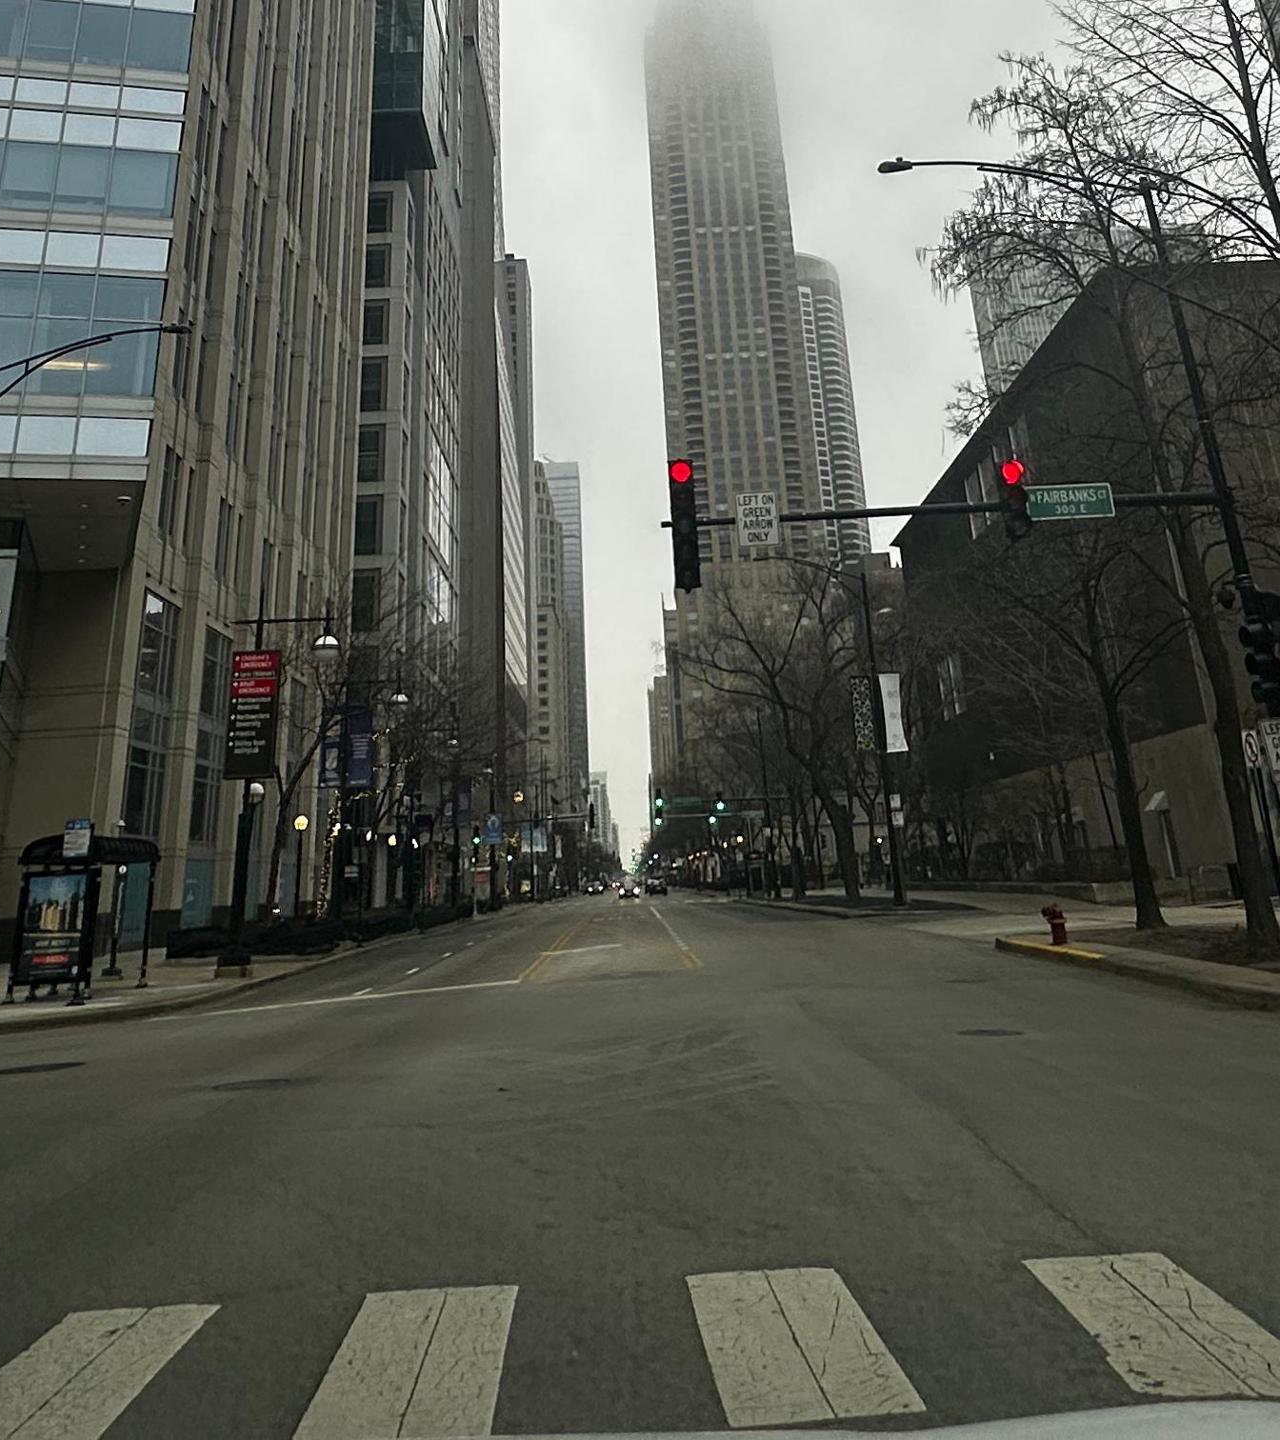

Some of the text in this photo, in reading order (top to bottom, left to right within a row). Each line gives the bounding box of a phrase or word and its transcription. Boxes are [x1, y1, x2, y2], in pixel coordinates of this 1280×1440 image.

[737, 494, 774, 507] LEFT ON
[1036, 488, 1097, 504] FAIRBANKS
[742, 506, 772, 519] GREEN
[1055, 503, 1088, 514] 300 E
[742, 518, 773, 530] ARROW
[747, 531, 770, 543] ONLY
